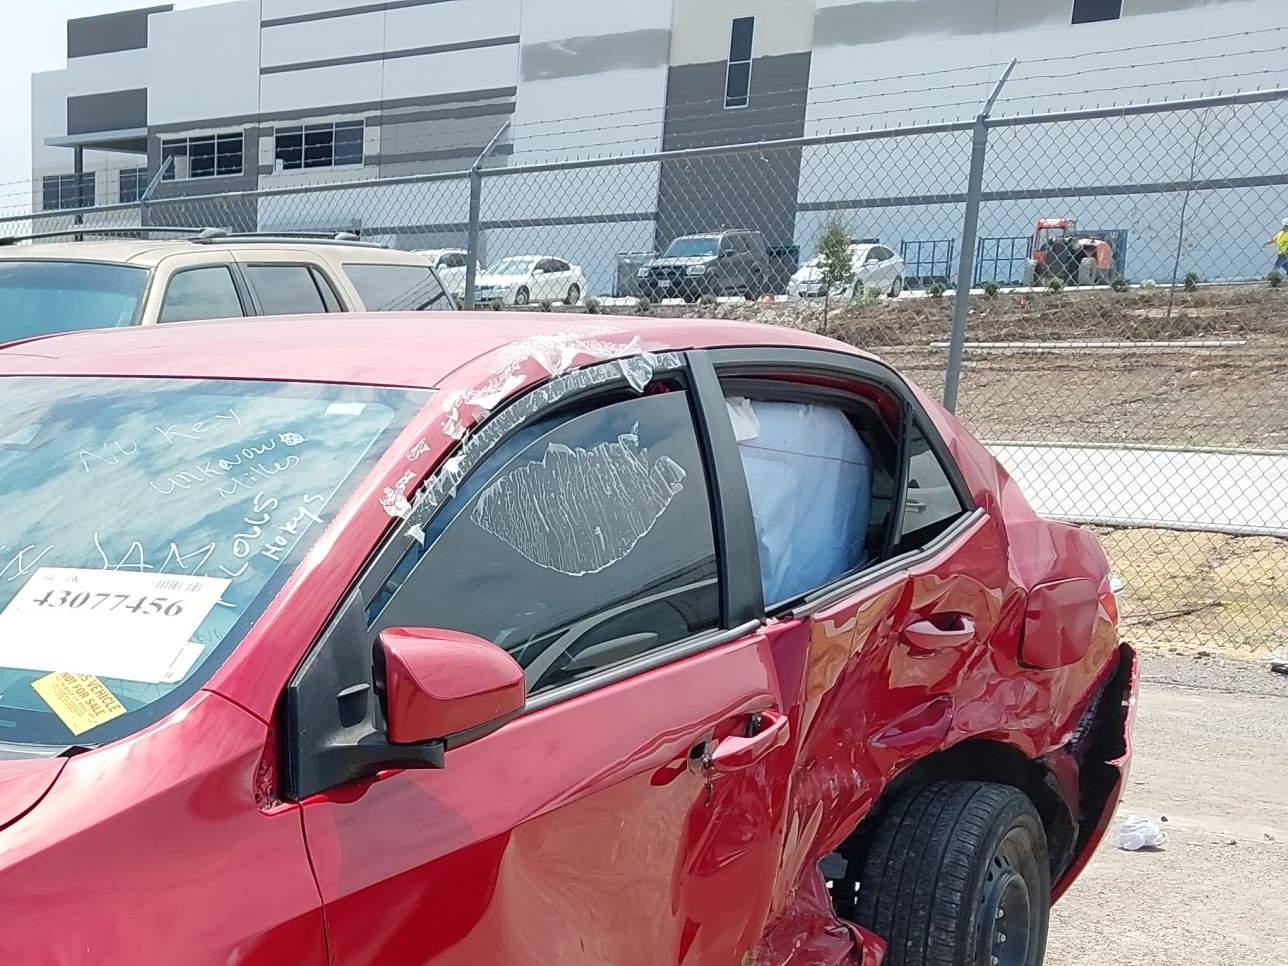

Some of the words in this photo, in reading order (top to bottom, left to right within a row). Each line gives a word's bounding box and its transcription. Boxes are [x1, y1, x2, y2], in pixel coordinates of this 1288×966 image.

[32, 589, 185, 617] 43077456
[72, 683, 90, 700] FOR
[85, 698, 106, 717] SALE
[87, 678, 121, 713] VEHICLE
